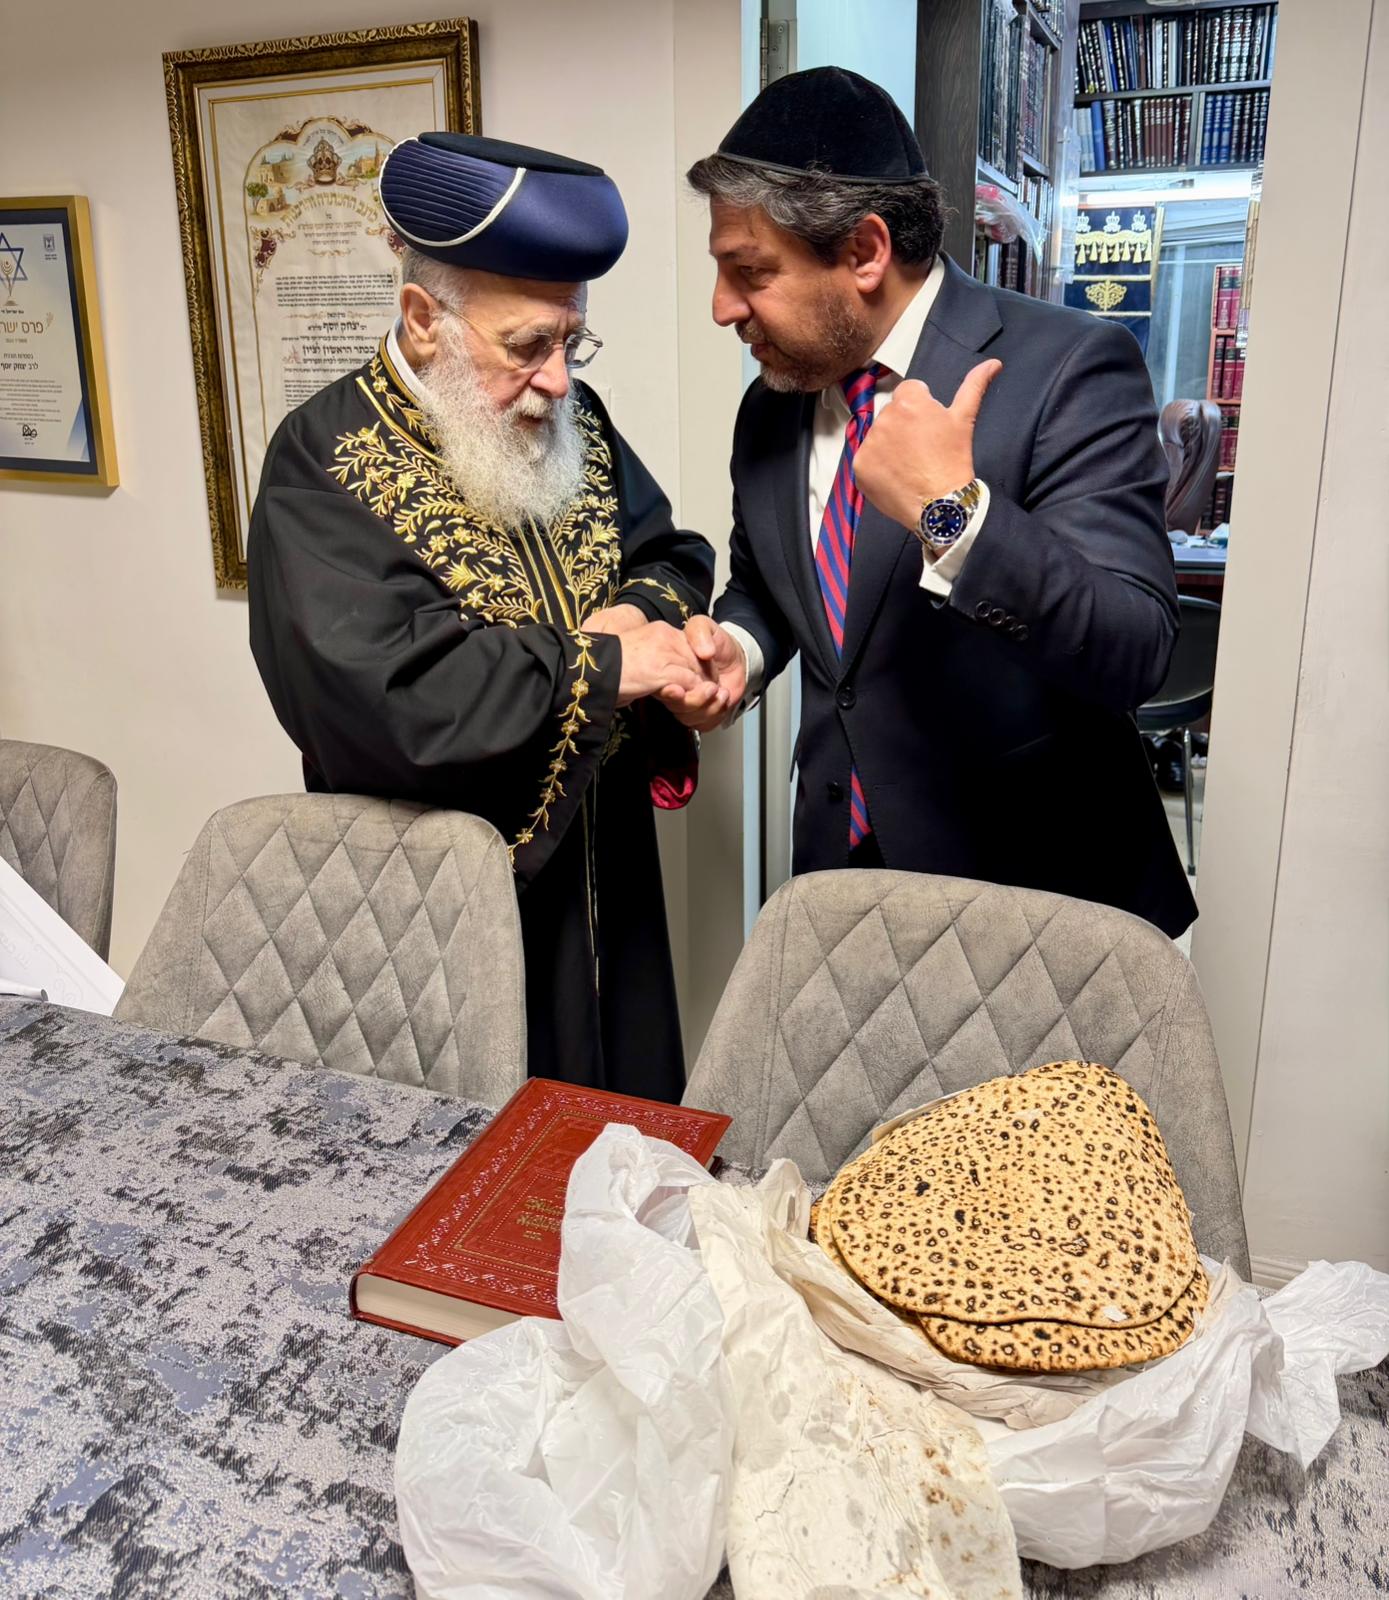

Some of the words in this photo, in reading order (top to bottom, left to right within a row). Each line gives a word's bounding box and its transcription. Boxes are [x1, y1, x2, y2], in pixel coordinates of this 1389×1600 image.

[22, 321, 44, 334] פרס
[323, 322, 339, 333] יוסף
[340, 321, 359, 333] יצחק
[302, 342, 320, 356] לציון
[322, 345, 352, 356] הראשון
[354, 345, 375, 354] בכתר
